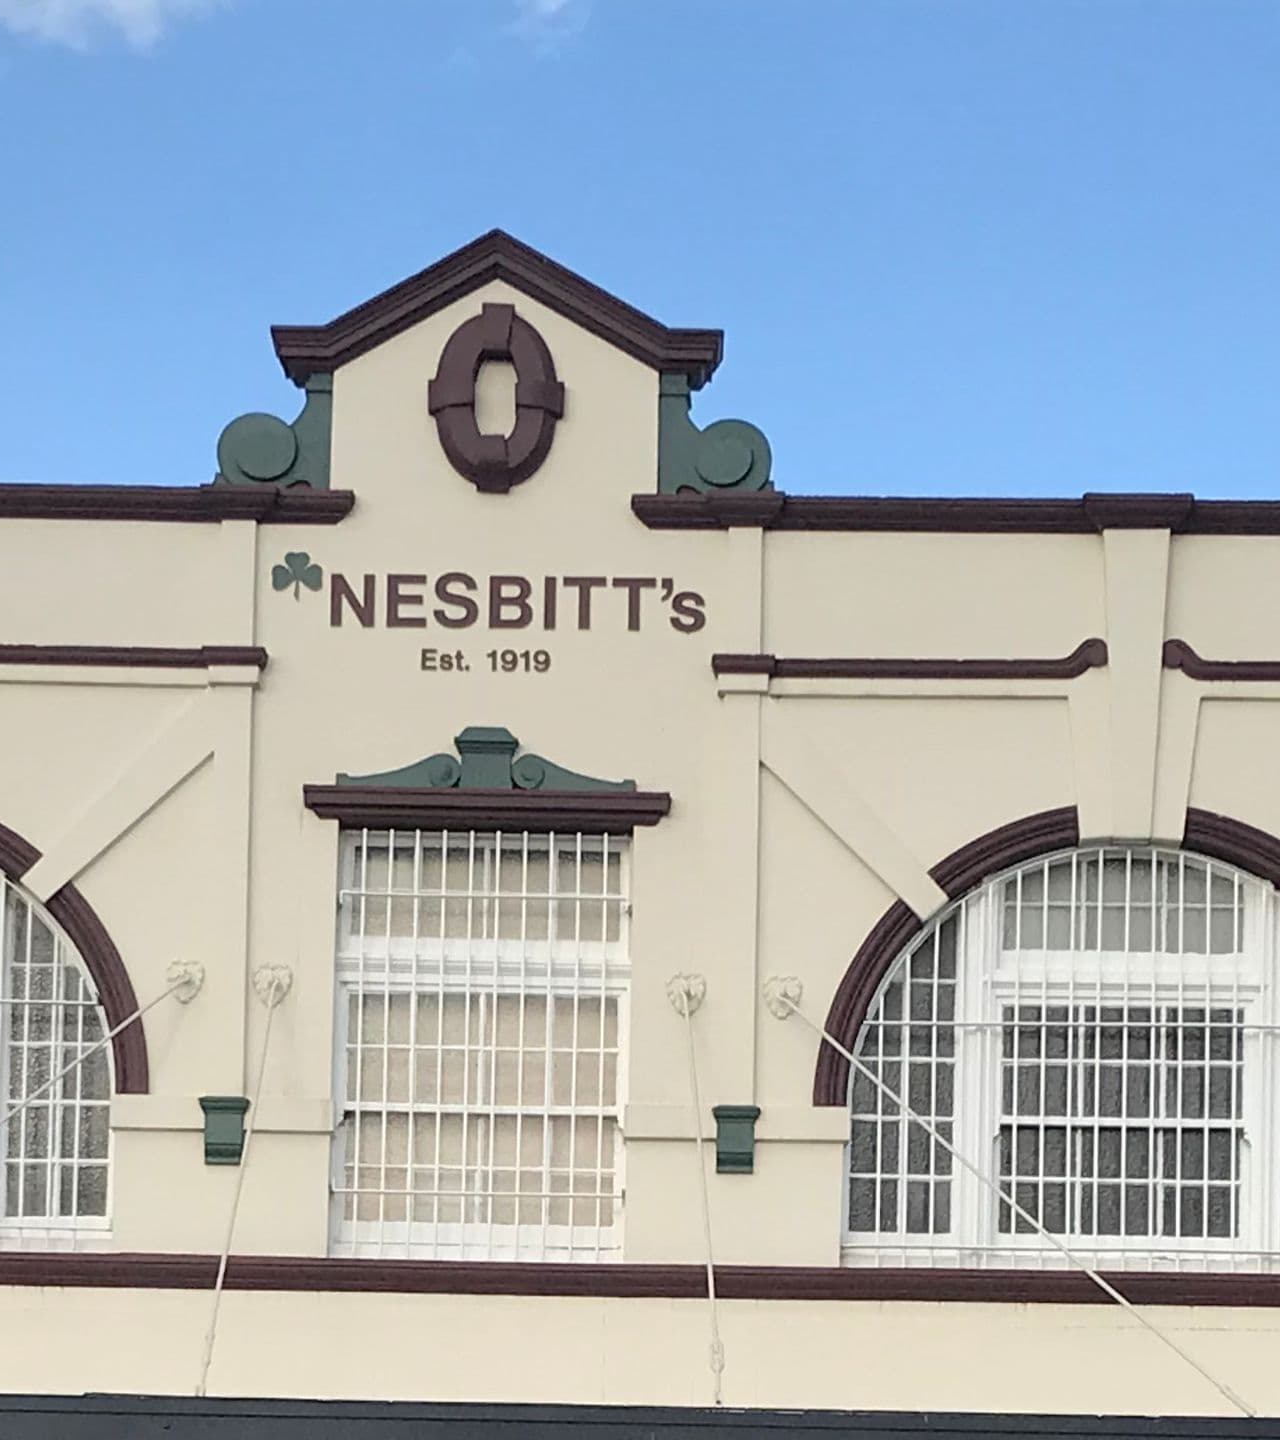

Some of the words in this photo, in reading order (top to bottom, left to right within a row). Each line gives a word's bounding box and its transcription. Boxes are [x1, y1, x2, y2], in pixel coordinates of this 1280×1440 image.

[329, 572, 707, 634] NESBITT's
[420, 649, 470, 672] Est.
[487, 649, 551, 673] 1919
